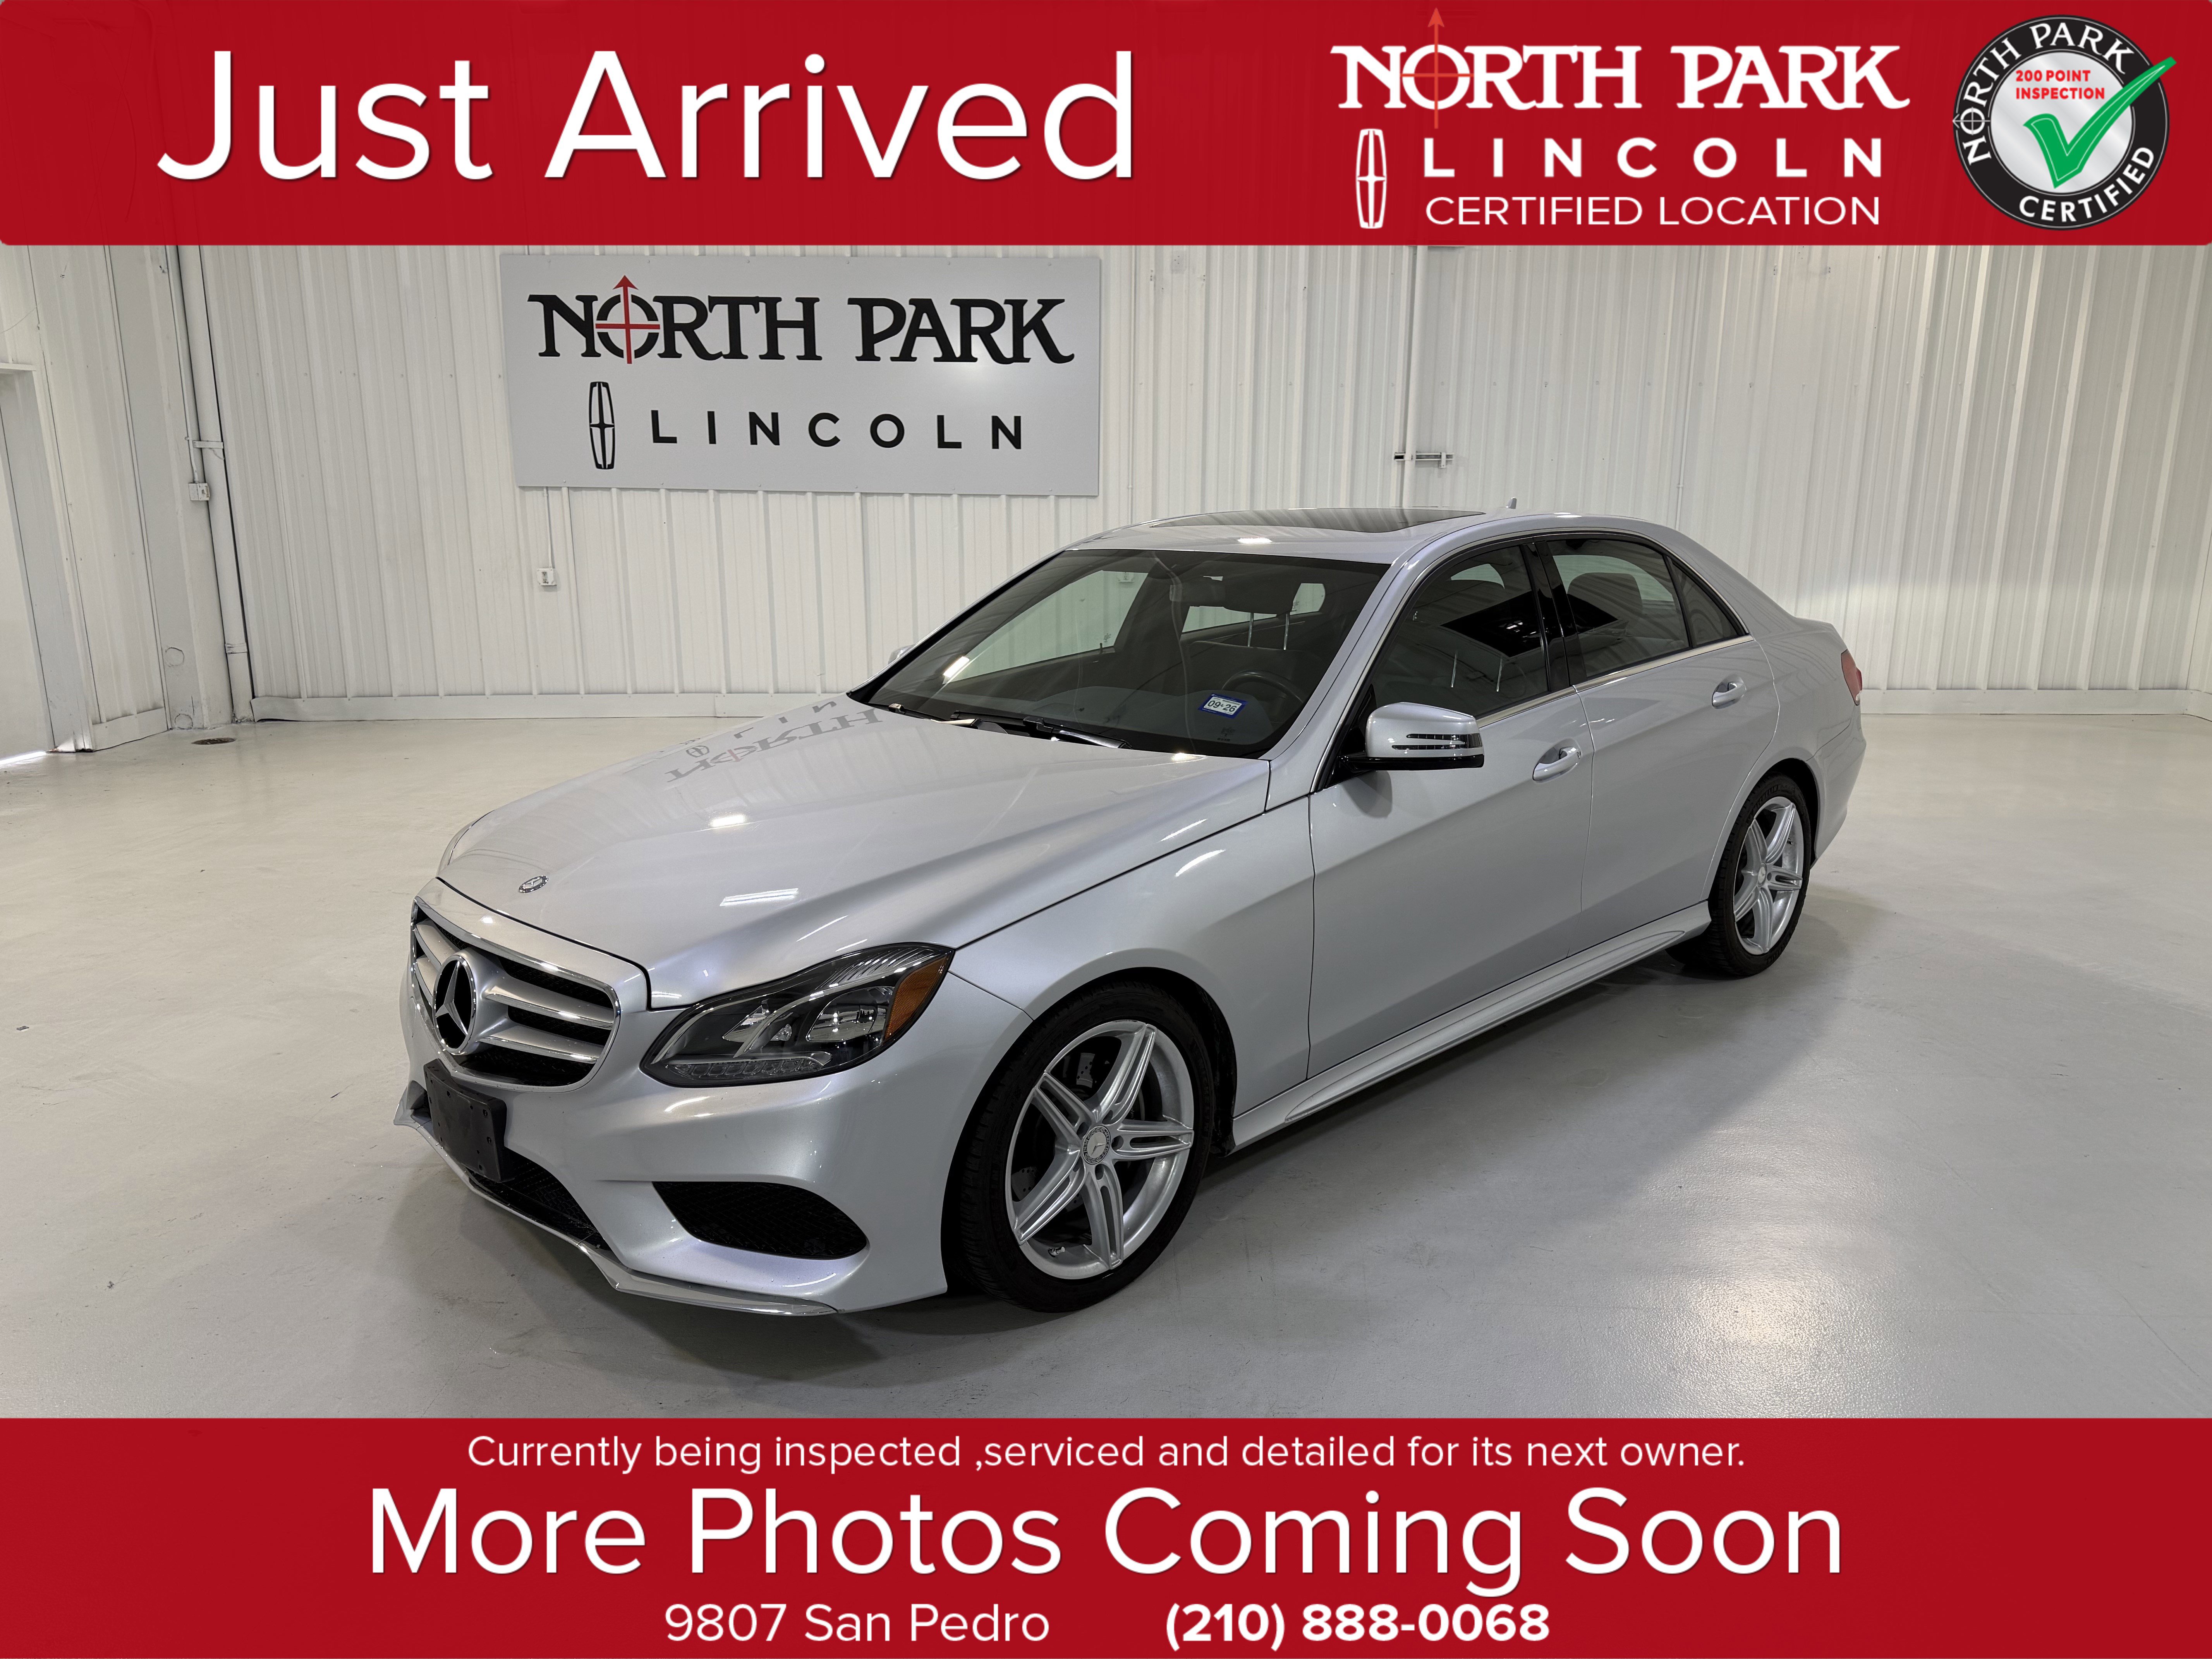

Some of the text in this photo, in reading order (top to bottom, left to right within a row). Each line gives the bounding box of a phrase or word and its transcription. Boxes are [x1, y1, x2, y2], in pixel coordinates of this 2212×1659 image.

[527, 294, 1074, 364] NORTH PARK
[651, 410, 1021, 449] LINCOLN
